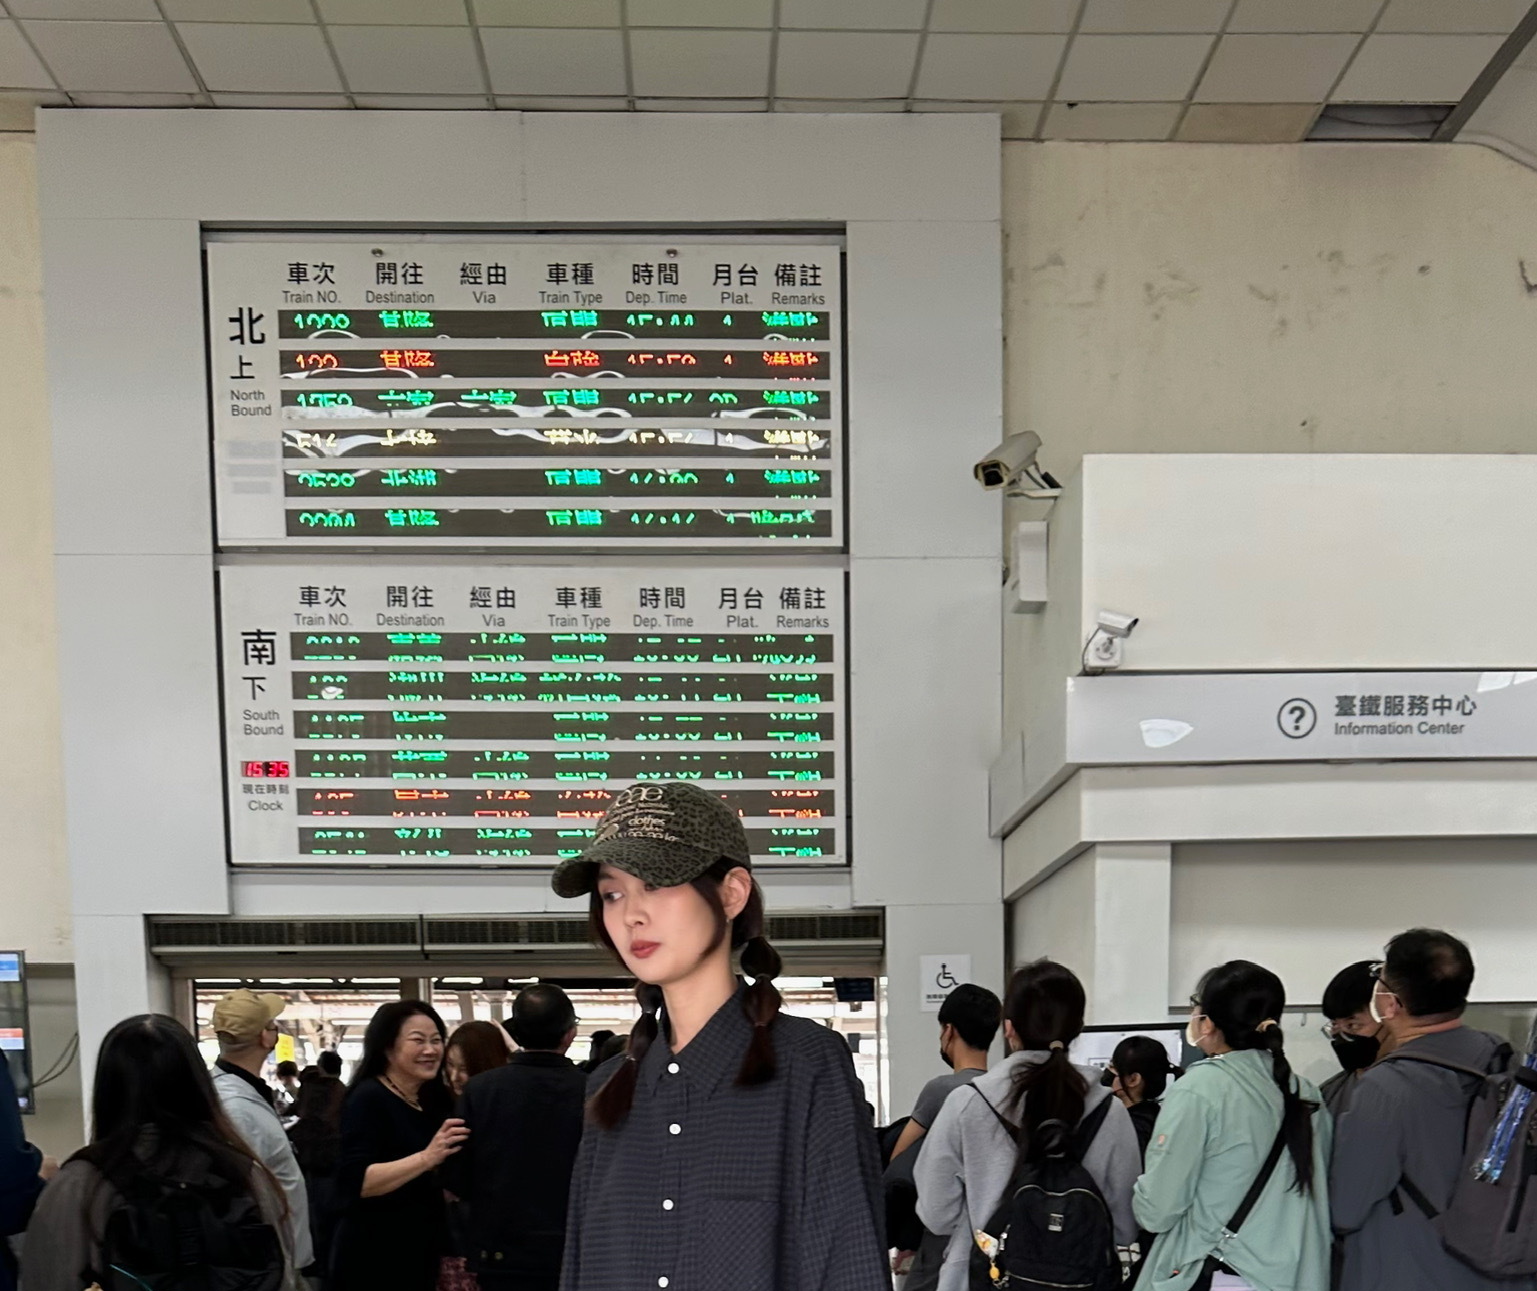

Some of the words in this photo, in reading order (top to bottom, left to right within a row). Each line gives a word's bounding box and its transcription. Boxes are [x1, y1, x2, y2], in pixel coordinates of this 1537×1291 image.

[288, 262, 335, 285] 車次
[376, 262, 423, 285] 開往
[460, 263, 506, 285] 經由
[546, 263, 594, 285] 車種
[632, 263, 678, 285] 時間
[713, 264, 758, 286] 月台
[774, 264, 822, 286] 備註
[282, 290, 313, 303] Train
[317, 290, 341, 303] NO.
[366, 290, 434, 303] Destination
[472, 291, 496, 304] Via
[539, 291, 569, 303] Train
[573, 291, 602, 306] Type
[626, 291, 653, 306] Dep.
[658, 291, 687, 304] Time
[721, 292, 752, 304] Plat.
[772, 292, 825, 305] Remarks
[231, 390, 265, 400] North
[231, 404, 272, 416] Bound
[299, 586, 346, 607] 車次
[387, 586, 433, 608] 開往
[470, 587, 515, 608] 經由
[556, 587, 602, 608] 車種
[640, 587, 685, 609] 時間
[719, 587, 763, 609] 月台
[779, 587, 826, 609] 備註
[294, 613, 325, 626] Train
[329, 613, 352, 626] NO.
[376, 613, 444, 626] Destination
[482, 614, 505, 627] Via
[548, 614, 578, 627] Train
[582, 614, 610, 630] Type
[633, 614, 661, 629] Dep.
[664, 614, 693, 627] Time
[727, 615, 758, 628] Plat.
[777, 615, 829, 628] Remarks
[1335, 695, 1477, 716] 臺鐵服務中心
[243, 709, 279, 720] South
[243, 724, 284, 735] Bound
[1335, 722, 1413, 735] Information
[1417, 721, 1465, 734] Center
[248, 800, 283, 811] Clock
